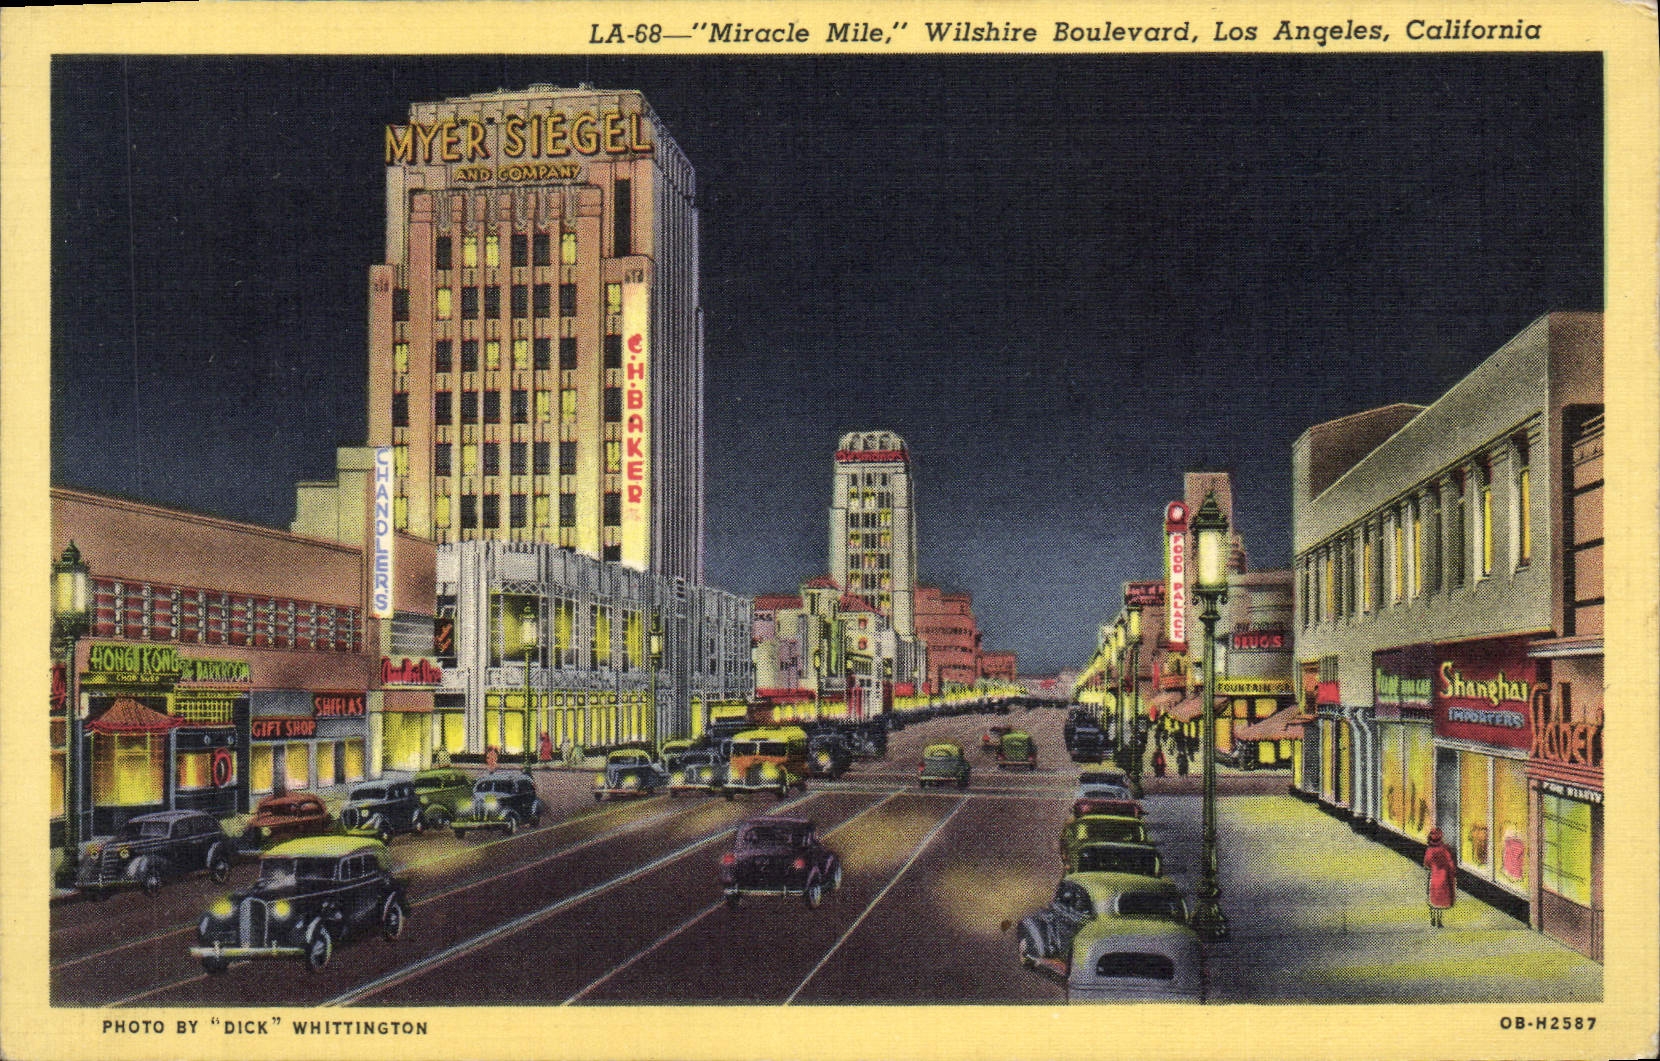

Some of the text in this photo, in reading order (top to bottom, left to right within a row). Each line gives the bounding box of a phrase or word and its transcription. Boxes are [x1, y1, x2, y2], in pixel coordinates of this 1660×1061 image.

[384, 112, 653, 166] MYER SIEGEL
[453, 163, 582, 182] AND COMPANY
[1173, 535, 1184, 639] FOOD PALACE
[1233, 634, 1284, 649] DRUGS
[90, 644, 180, 675] HONG KONG
[1217, 682, 1271, 693] FOUNTAIN
[1439, 661, 1529, 707] Shanghai
[251, 720, 317, 738] GIFT SHOP
